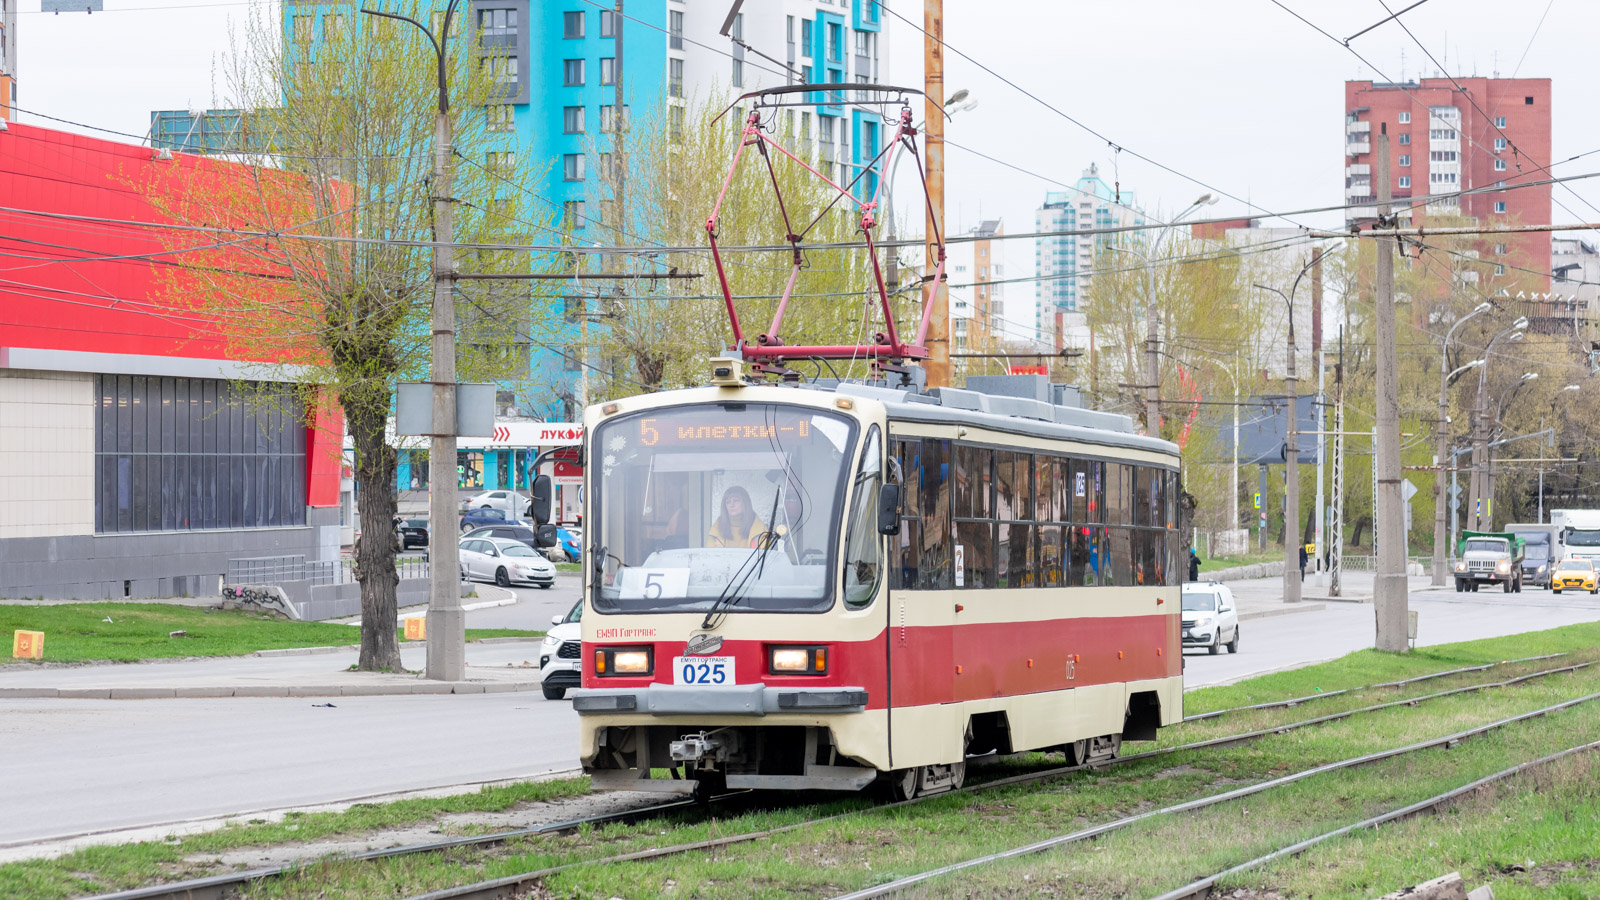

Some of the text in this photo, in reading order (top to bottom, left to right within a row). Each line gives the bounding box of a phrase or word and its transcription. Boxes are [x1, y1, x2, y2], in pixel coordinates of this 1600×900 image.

[641, 419, 659, 446] 5
[643, 573, 665, 600] 5
[683, 664, 726, 684] 025
